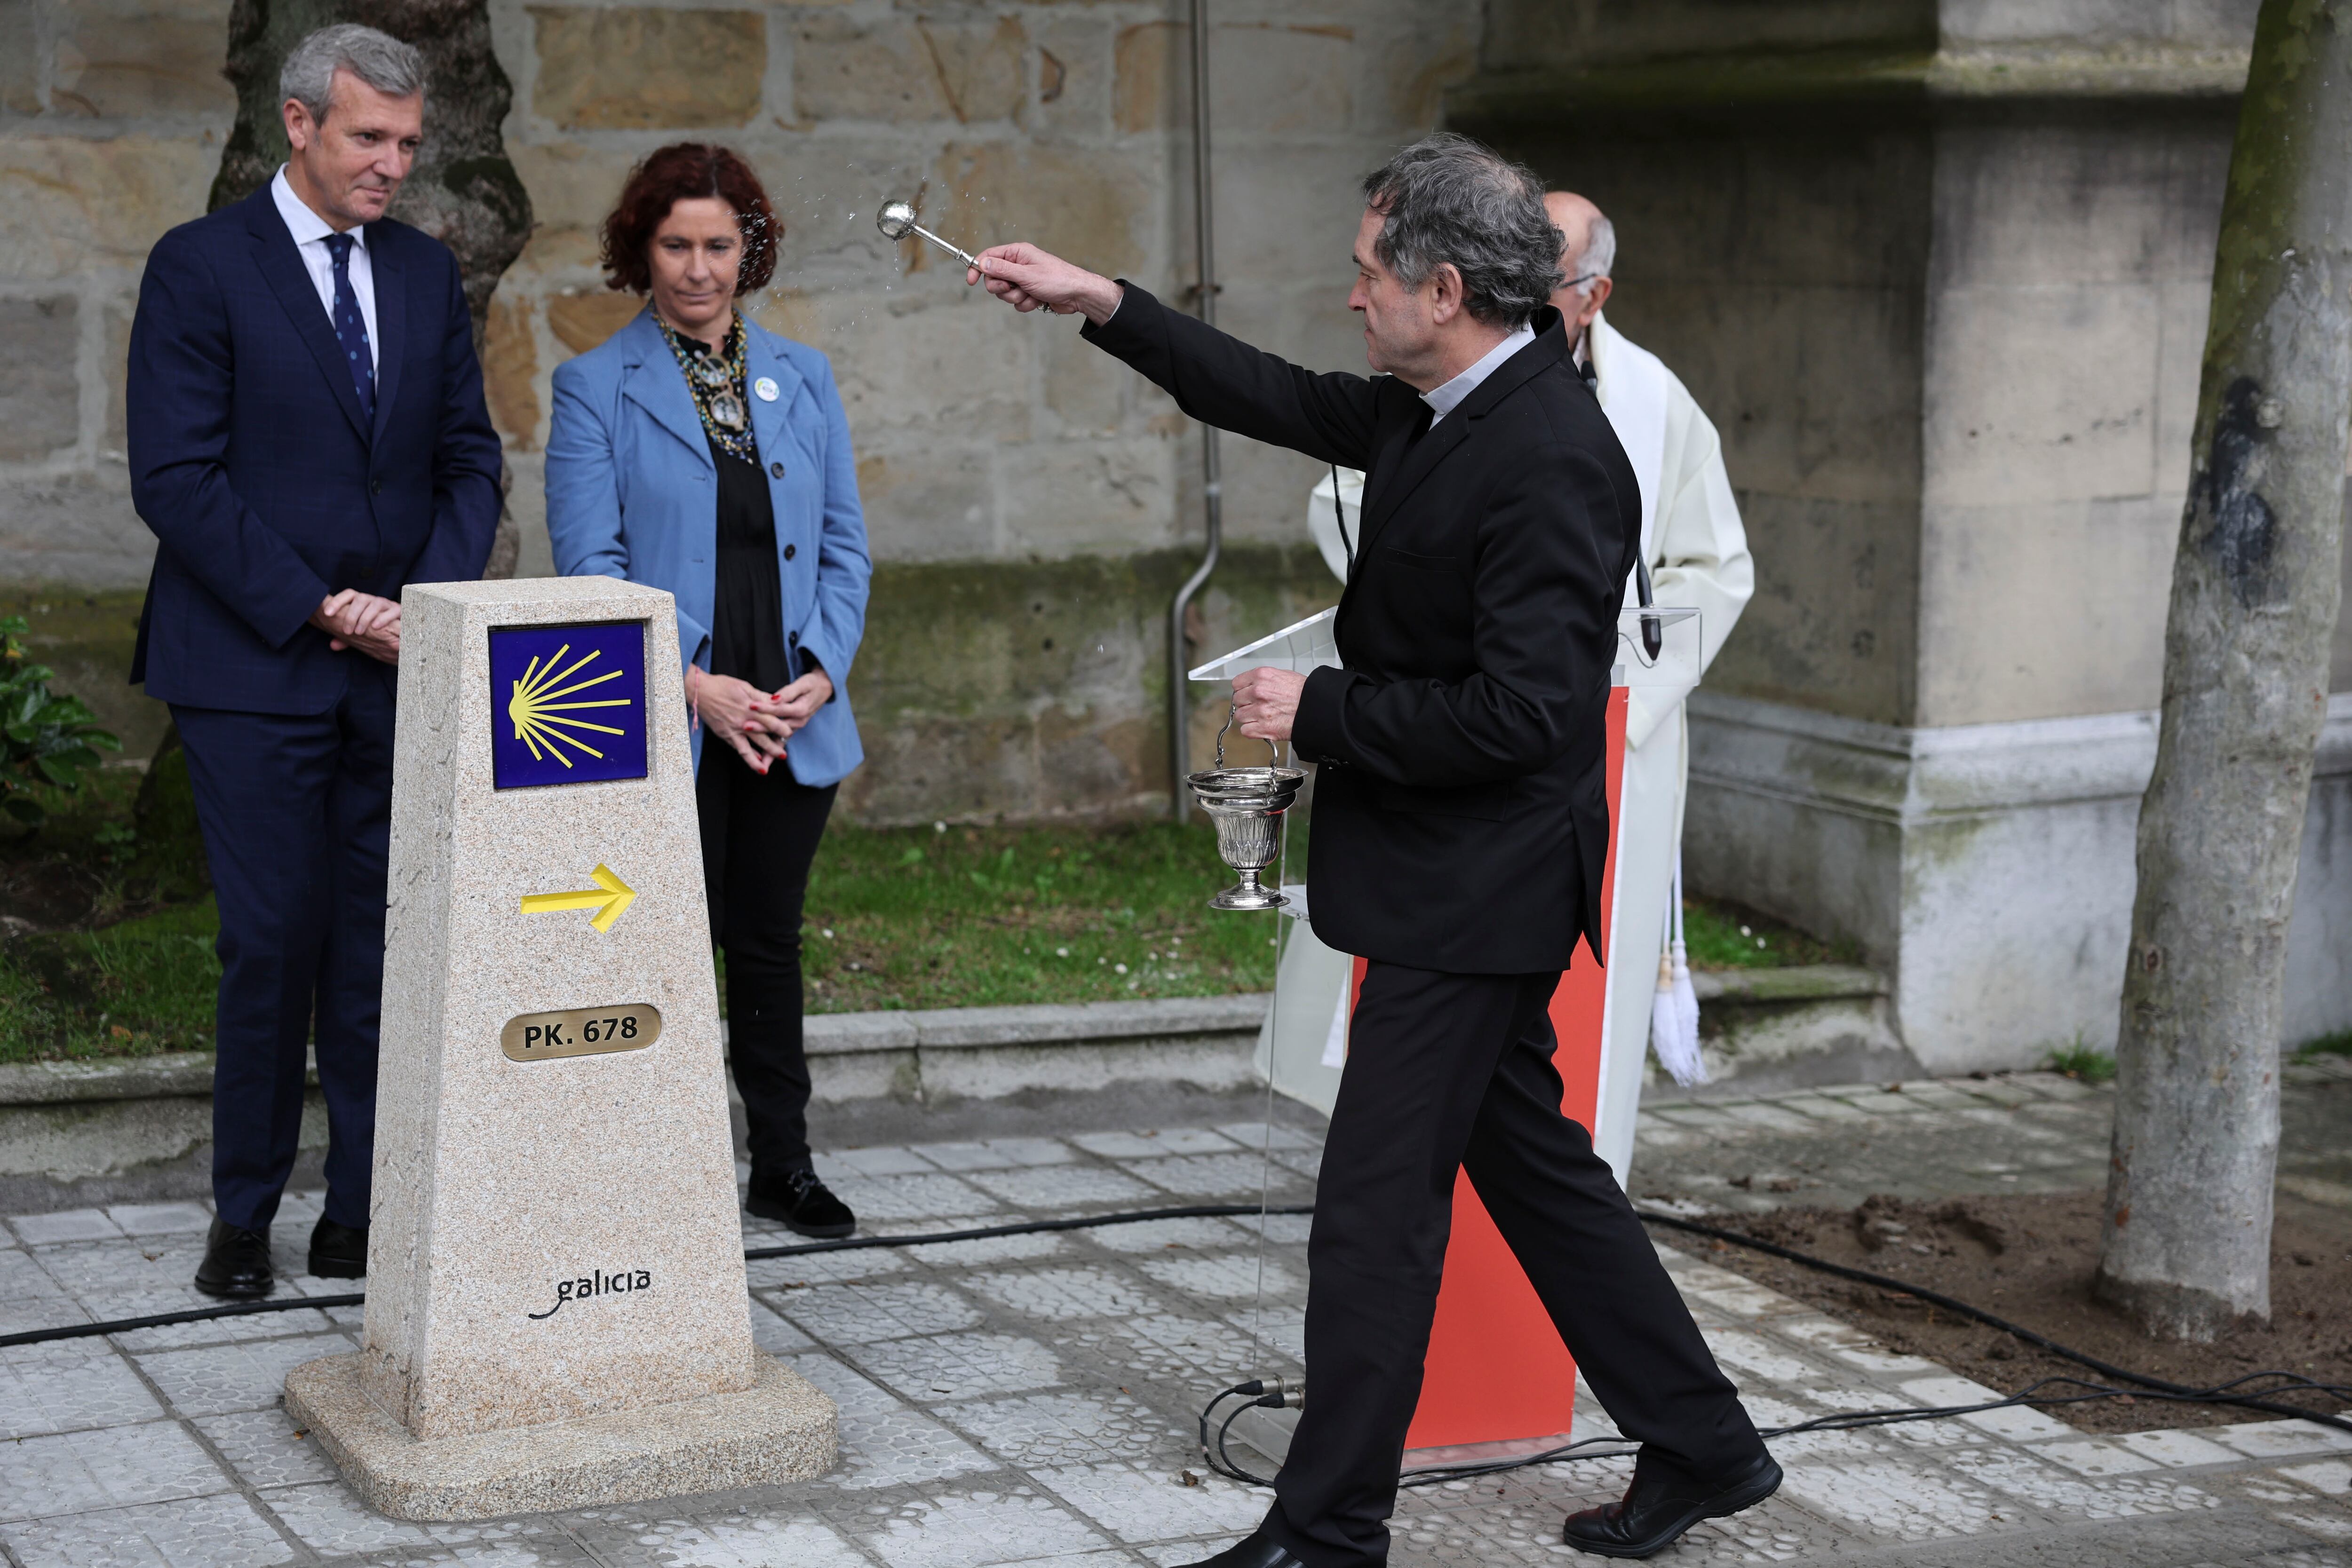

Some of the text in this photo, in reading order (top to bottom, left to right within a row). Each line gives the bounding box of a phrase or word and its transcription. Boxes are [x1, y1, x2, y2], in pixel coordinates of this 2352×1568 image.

[524, 1016, 638, 1048] PK. 678
[528, 1268, 651, 1319] galicia
